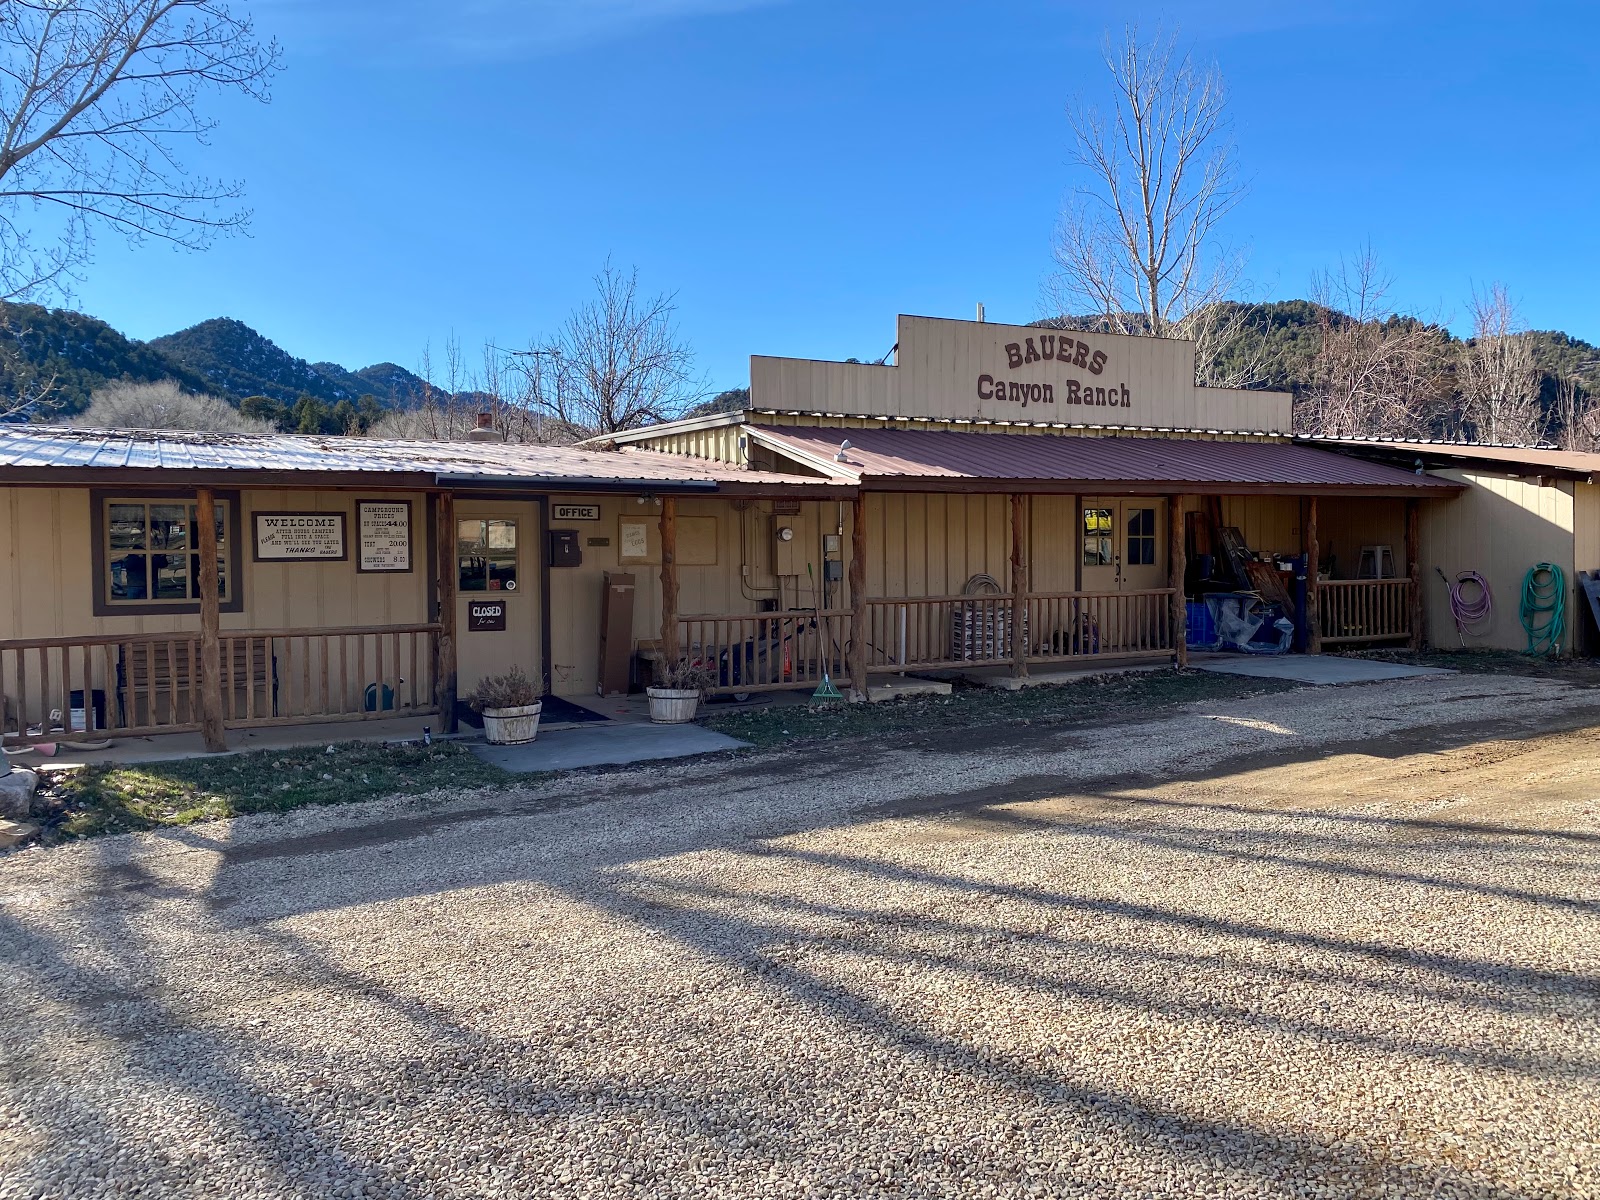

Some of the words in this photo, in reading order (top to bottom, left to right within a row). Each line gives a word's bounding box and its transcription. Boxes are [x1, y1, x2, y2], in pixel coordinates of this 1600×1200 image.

[1005, 335, 1108, 375] BAUERS
[977, 374, 1054, 408] Canyon
[1066, 379, 1130, 408] Ranch
[559, 507, 594, 518] OFFICE
[265, 518, 335, 527] WELCOME
[260, 533, 275, 544] PLEASE
[472, 606, 502, 617] CLOSED
